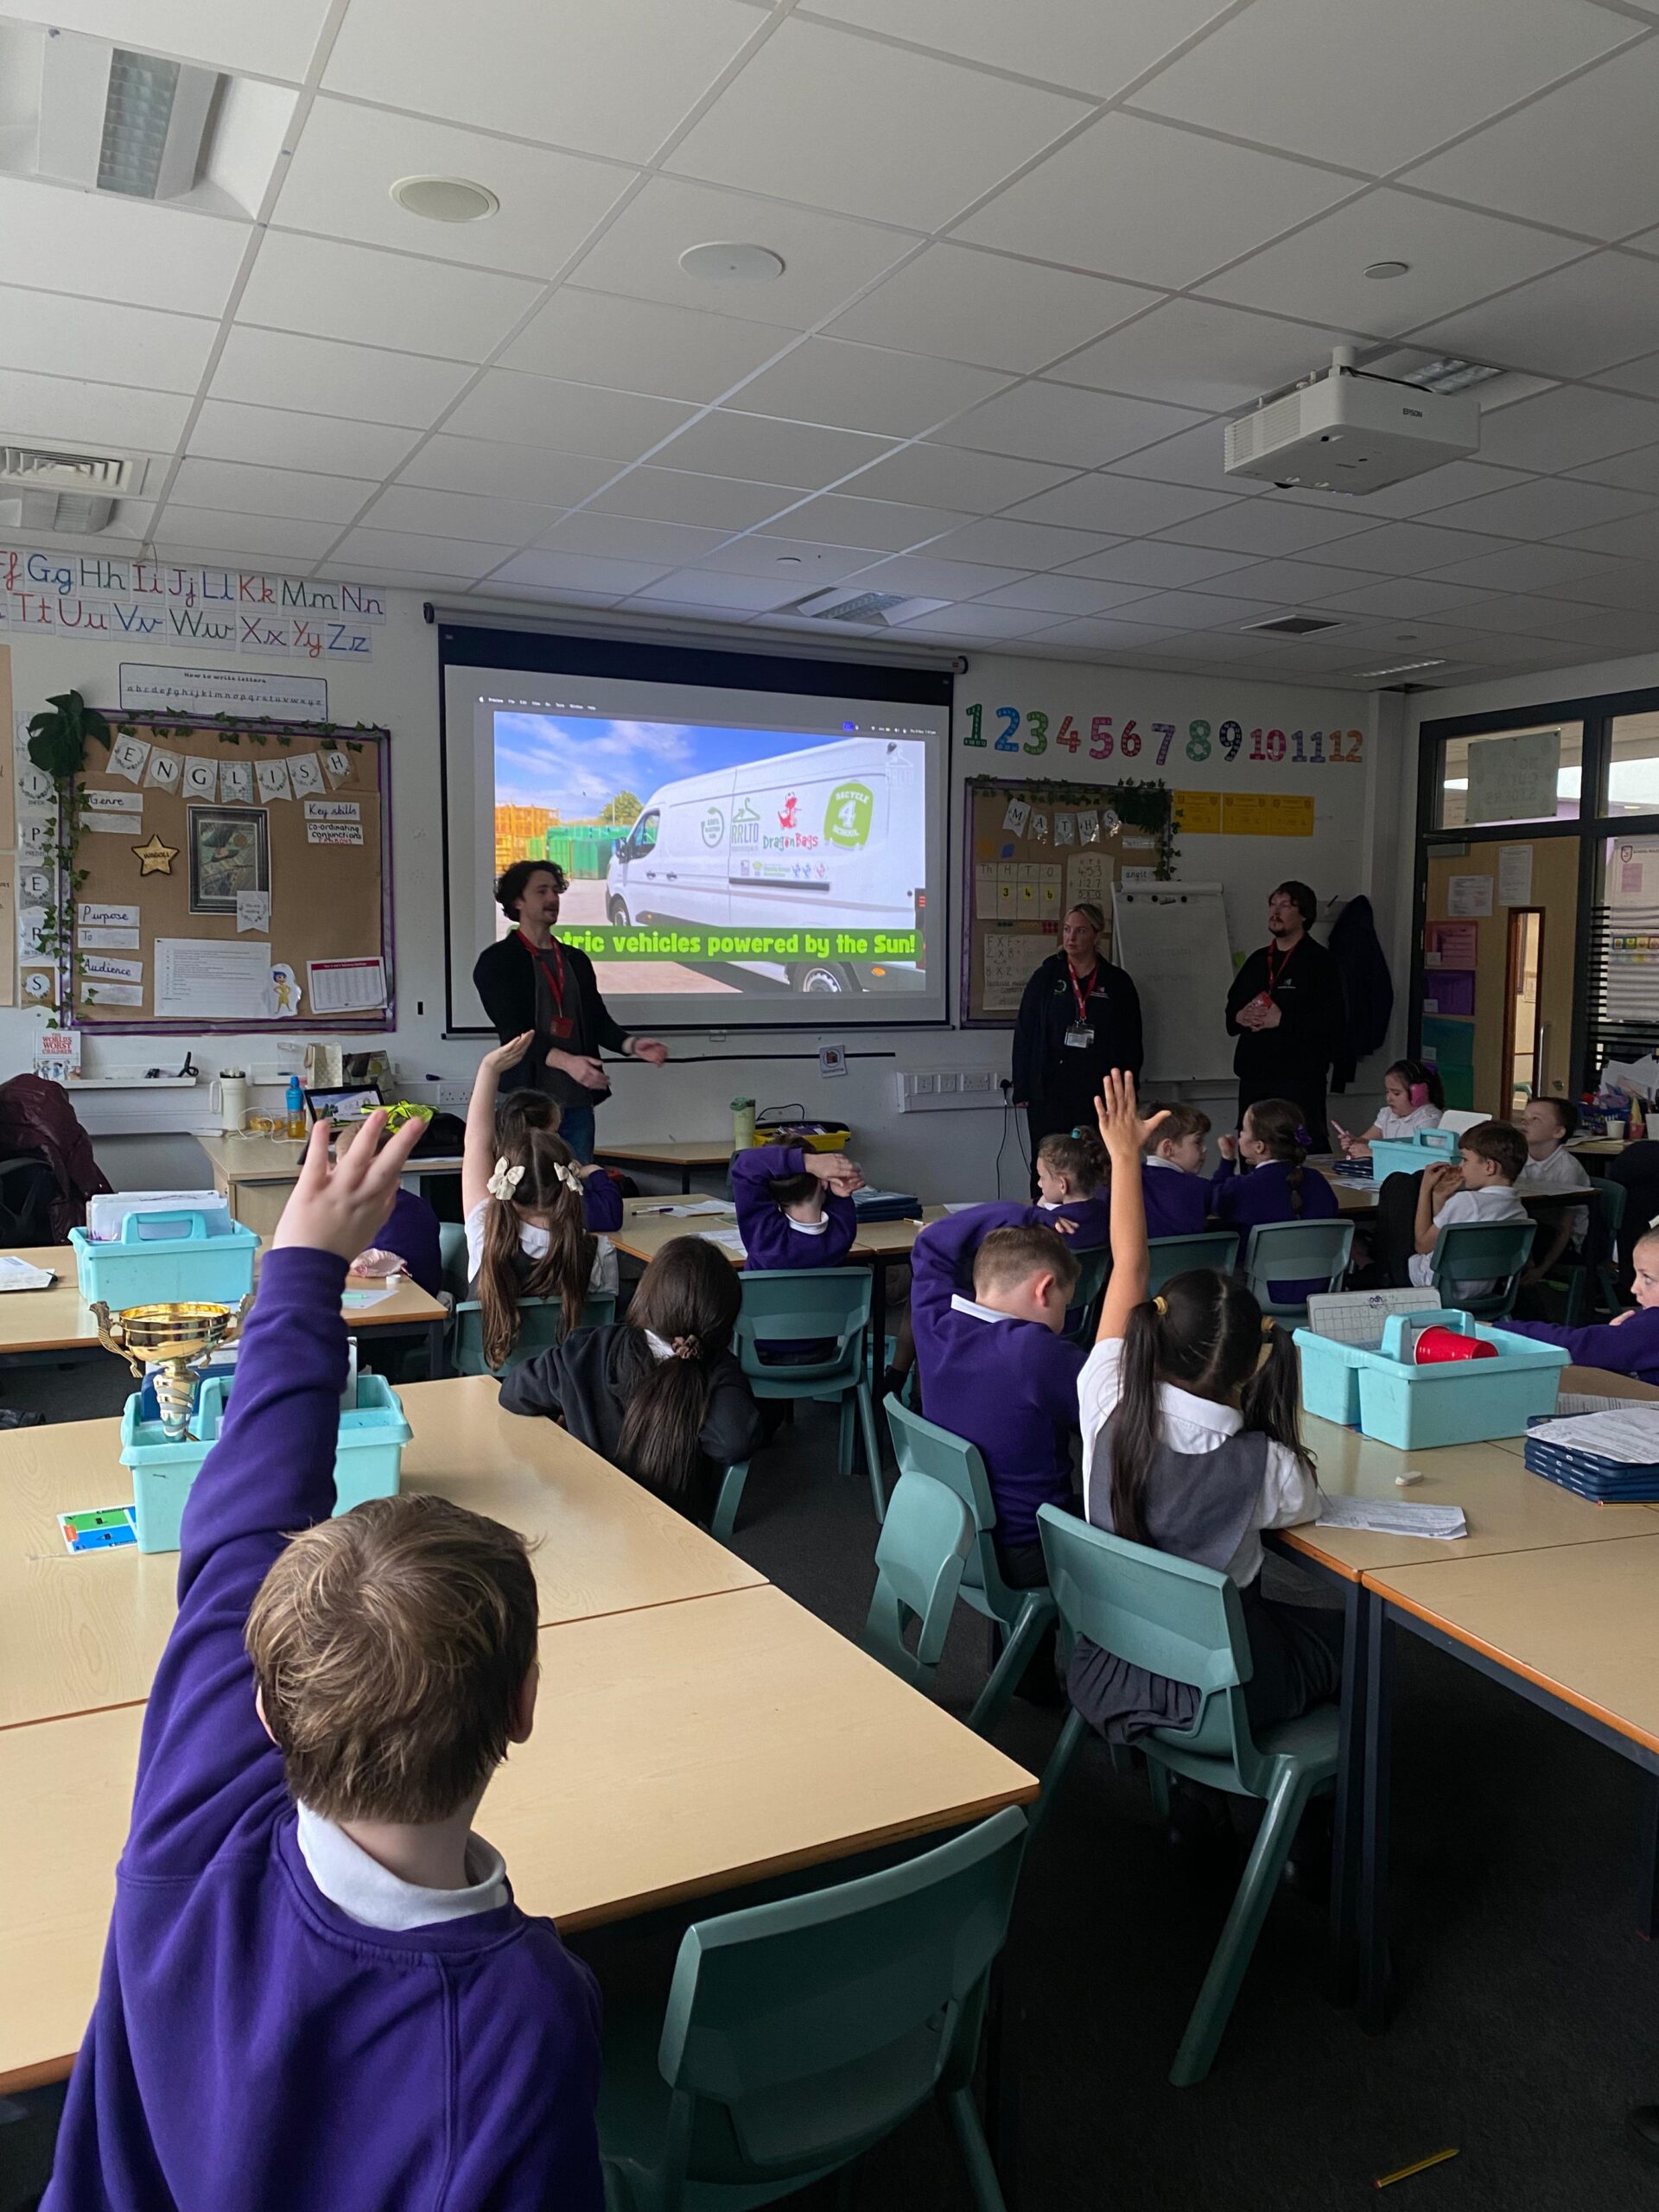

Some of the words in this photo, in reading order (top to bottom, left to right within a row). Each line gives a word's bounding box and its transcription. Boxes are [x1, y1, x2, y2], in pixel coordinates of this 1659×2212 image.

[1403, 407, 1423, 417] EPSON
[28, 553, 73, 595] Gg
[80, 558, 126, 590] Hh
[132, 563, 162, 594] Ii
[168, 569, 197, 607] Jj
[203, 570, 234, 601] Ll
[238, 574, 276, 603] Kk
[282, 579, 338, 610] Mm
[342, 584, 384, 615] Nn
[12, 592, 52, 623] Tt
[59, 598, 107, 630] Uu
[113, 603, 163, 633] Vv
[168, 607, 234, 639] Ww
[240, 615, 287, 646] Xx
[294, 620, 323, 658] Yy
[327, 623, 369, 652] Zz
[963, 703, 987, 747] 1
[995, 706, 1020, 753] 2
[1023, 711, 1048, 756] 3
[1056, 715, 1081, 753] 4
[1089, 716, 1114, 760] 5
[1121, 720, 1141, 757] 6
[1151, 722, 1175, 766] 7
[1185, 719, 1211, 761] 8
[1219, 720, 1243, 762] 9
[1249, 728, 1287, 762] 10
[1292, 730, 1325, 763] 11
[1329, 729, 1363, 763] 12
[90, 794, 124, 805] Genre
[308, 803, 327, 818] Key
[331, 804, 356, 815] skills
[837, 800, 856, 829] 4
[981, 864, 992, 874] Th
[1004, 865, 1011, 874] H
[1025, 865, 1032, 876] T
[1003, 887, 1009, 897] 3
[1025, 887, 1031, 897] 4
[1047, 890, 1052, 899] 6
[83, 905, 129, 925] Purpose
[81, 930, 92, 941] To
[556, 931, 605, 952] tric
[612, 931, 701, 953] vehicles
[707, 933, 799, 957] powered
[804, 933, 830, 958] by
[836, 933, 868, 953] the
[874, 934, 916, 954] Sun!
[84, 958, 131, 976] Audience
